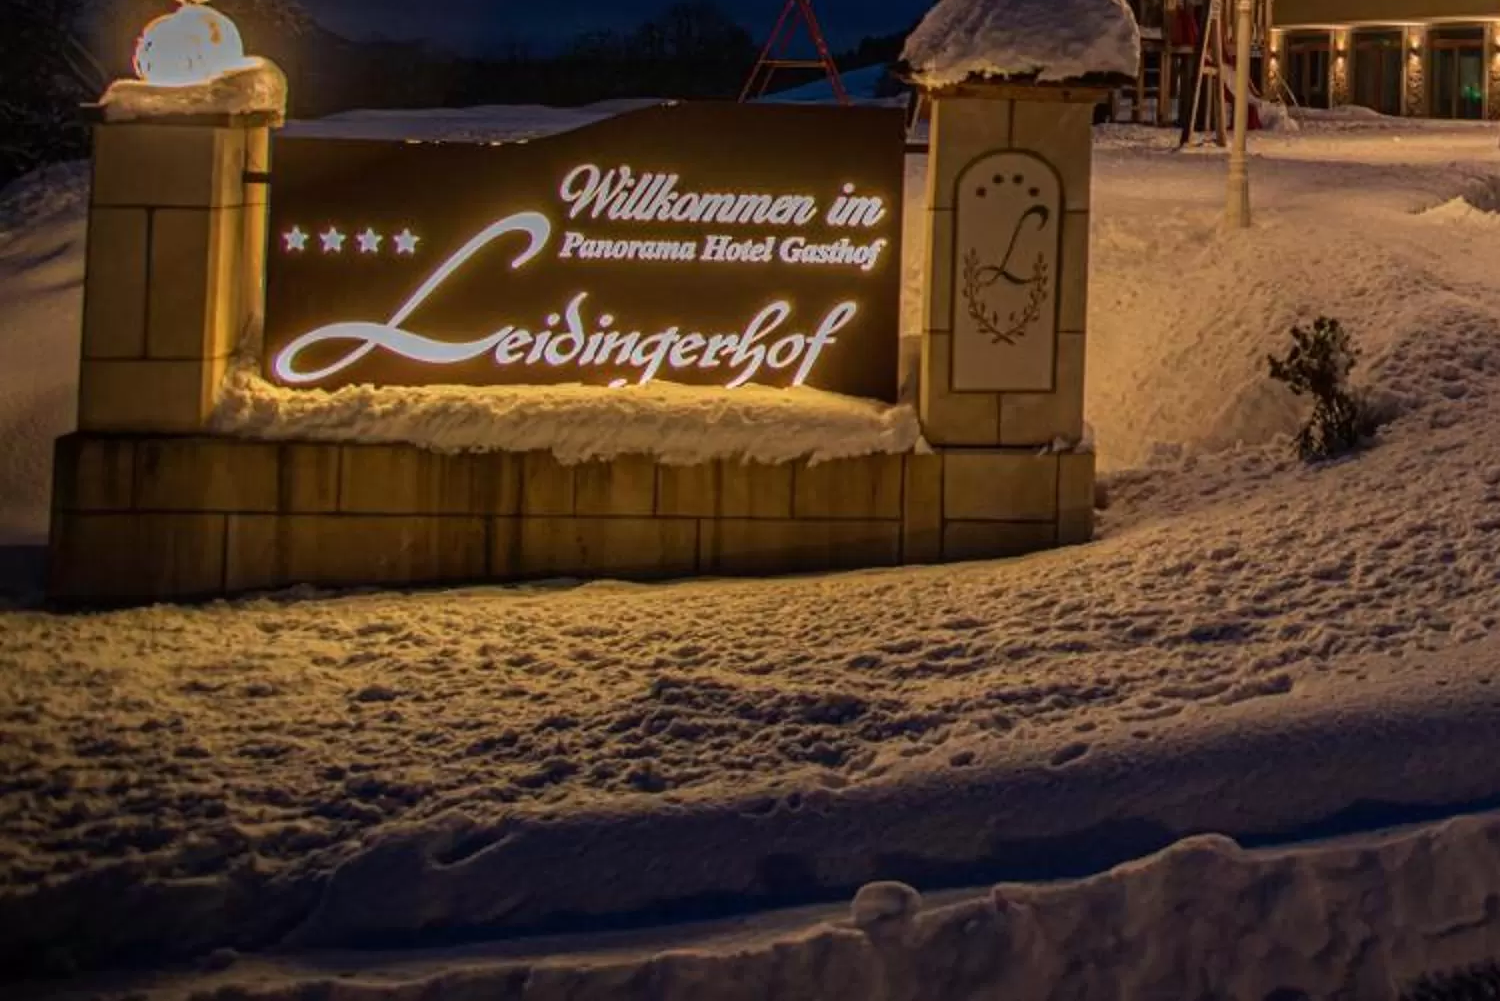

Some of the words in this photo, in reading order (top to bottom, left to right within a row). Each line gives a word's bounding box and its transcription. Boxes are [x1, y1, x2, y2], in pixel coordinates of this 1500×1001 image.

[559, 163, 818, 225] Willkommen
[826, 182, 888, 227] im
[558, 231, 697, 262] Panorama
[700, 234, 773, 264] Hotel
[779, 237, 887, 271] Gasthof
[274, 211, 858, 390] Leidingerhof
